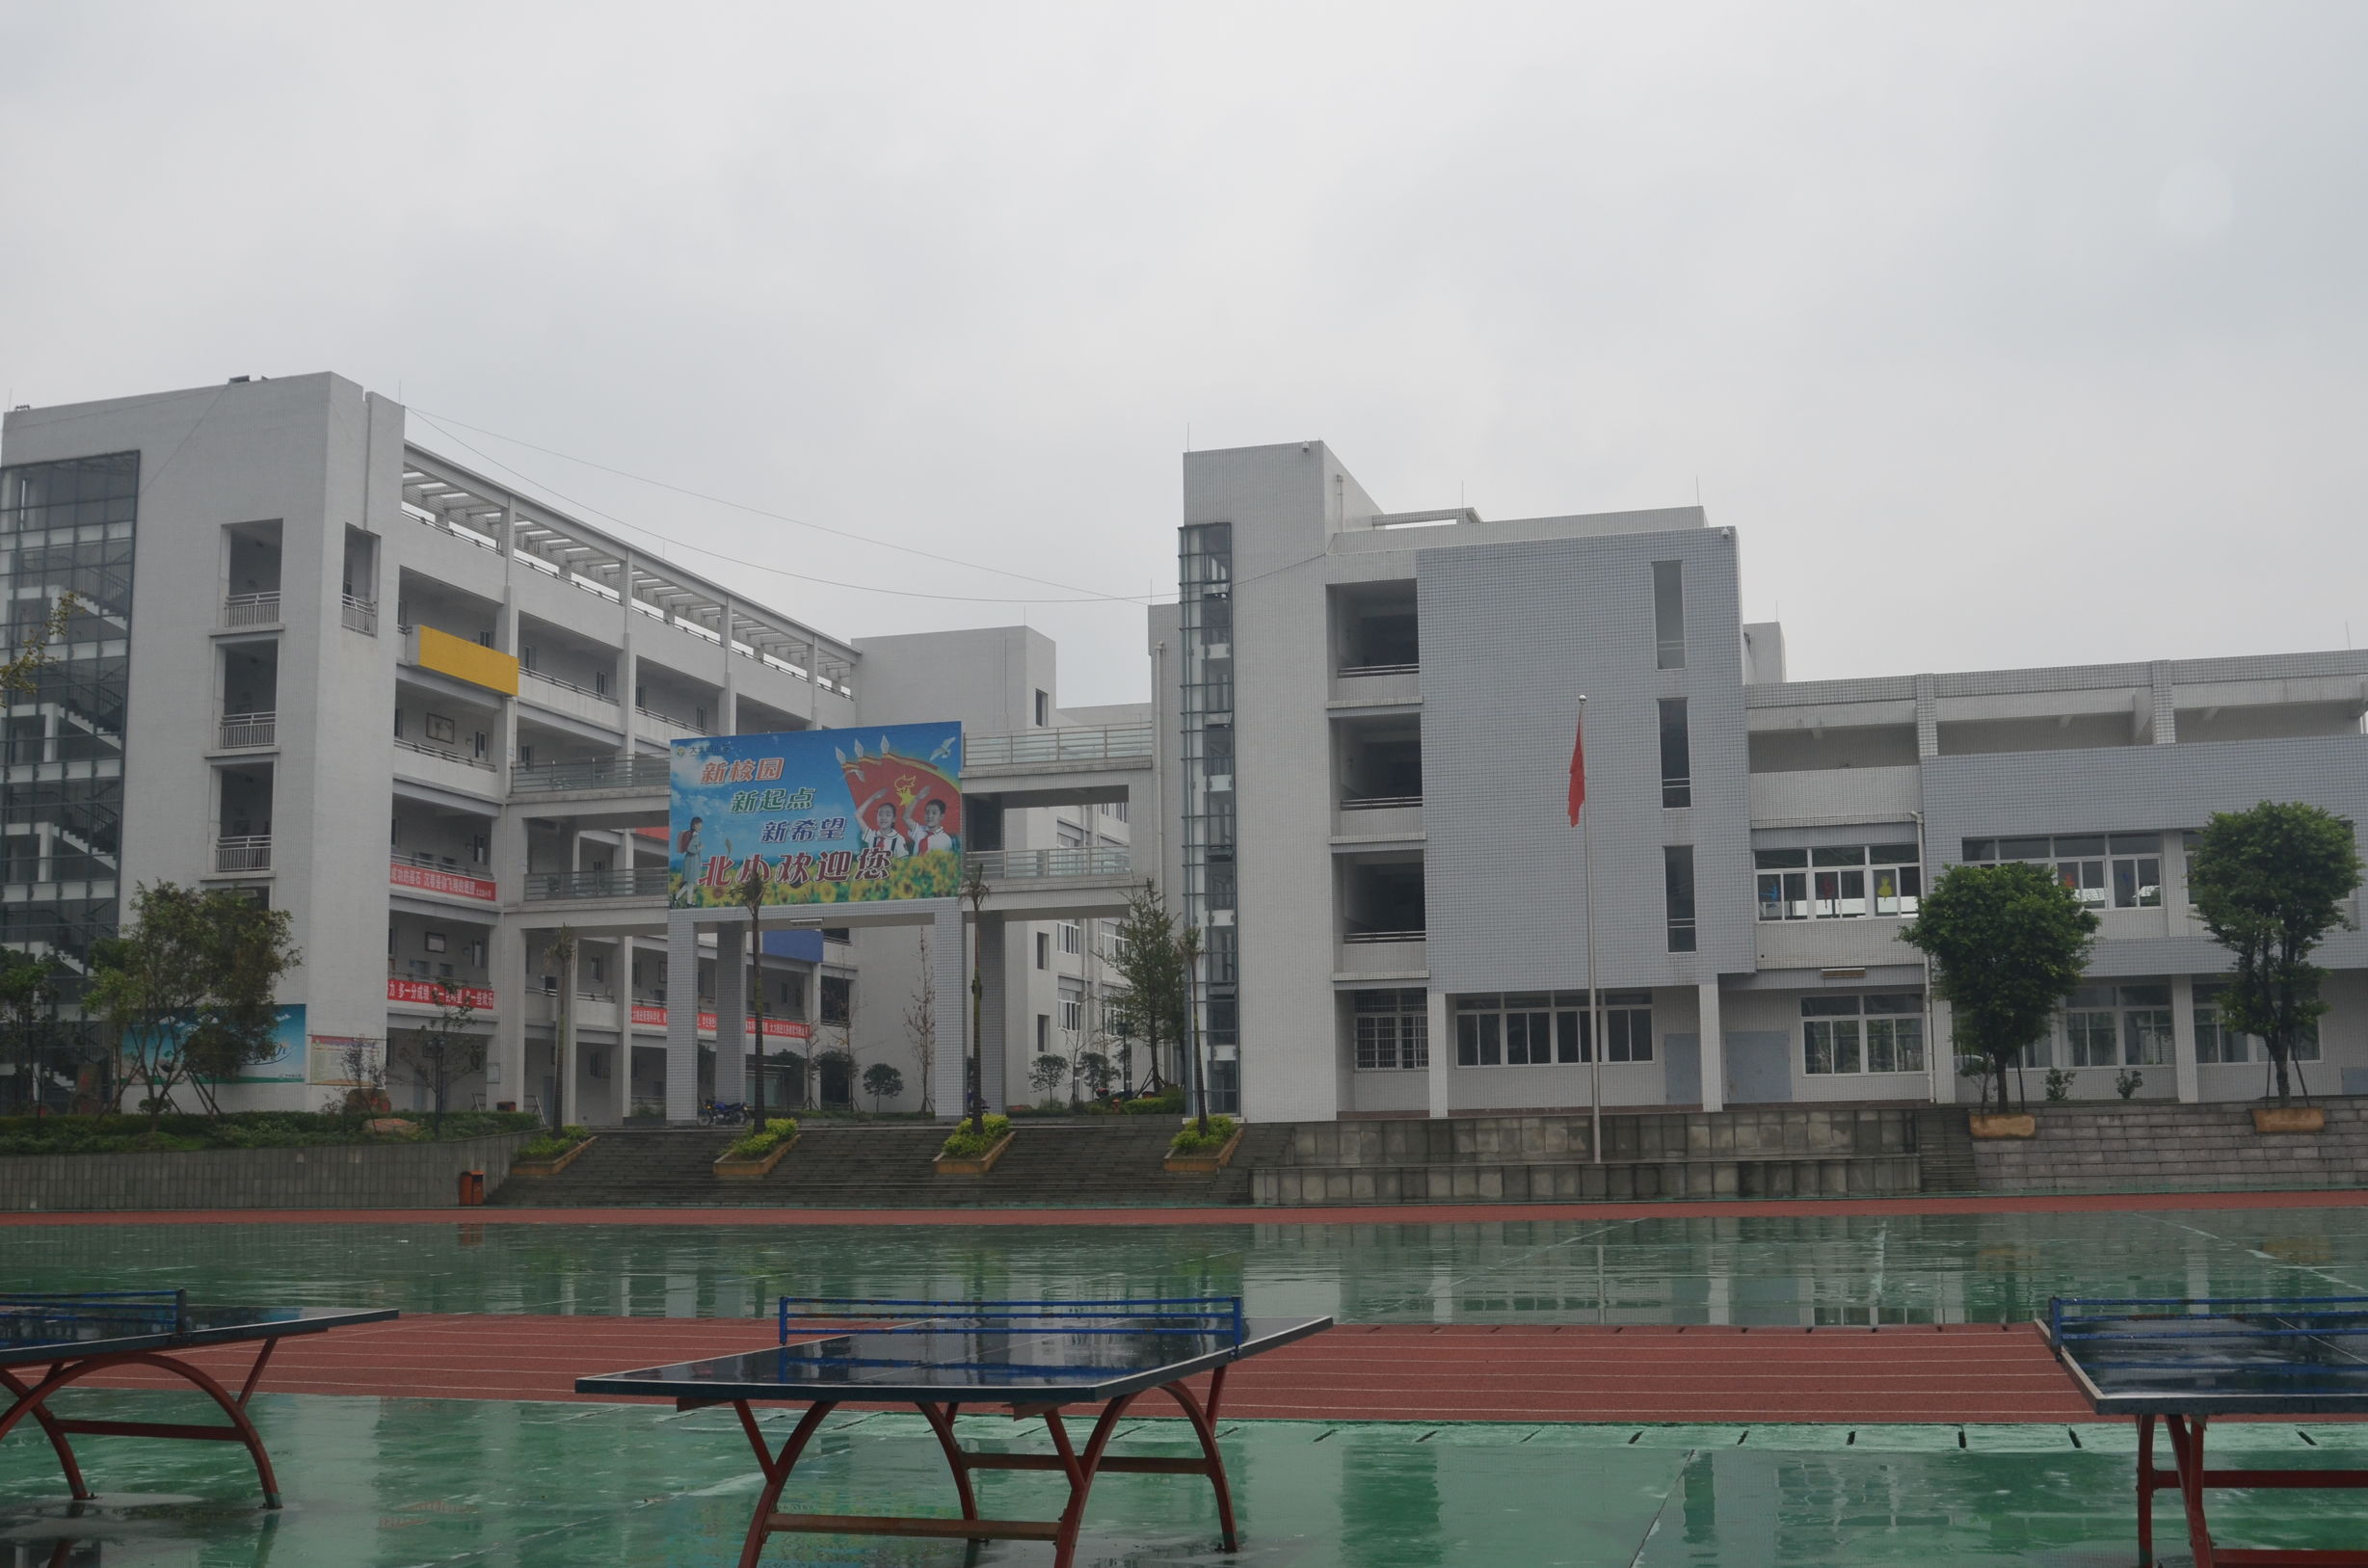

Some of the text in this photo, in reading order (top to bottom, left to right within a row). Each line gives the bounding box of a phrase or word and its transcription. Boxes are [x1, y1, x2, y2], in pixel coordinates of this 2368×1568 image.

[701, 757, 785, 784] 新校园
[731, 787, 817, 814] 新起点
[759, 817, 848, 843] 新希望
[697, 847, 893, 888] 北小欢迎您
